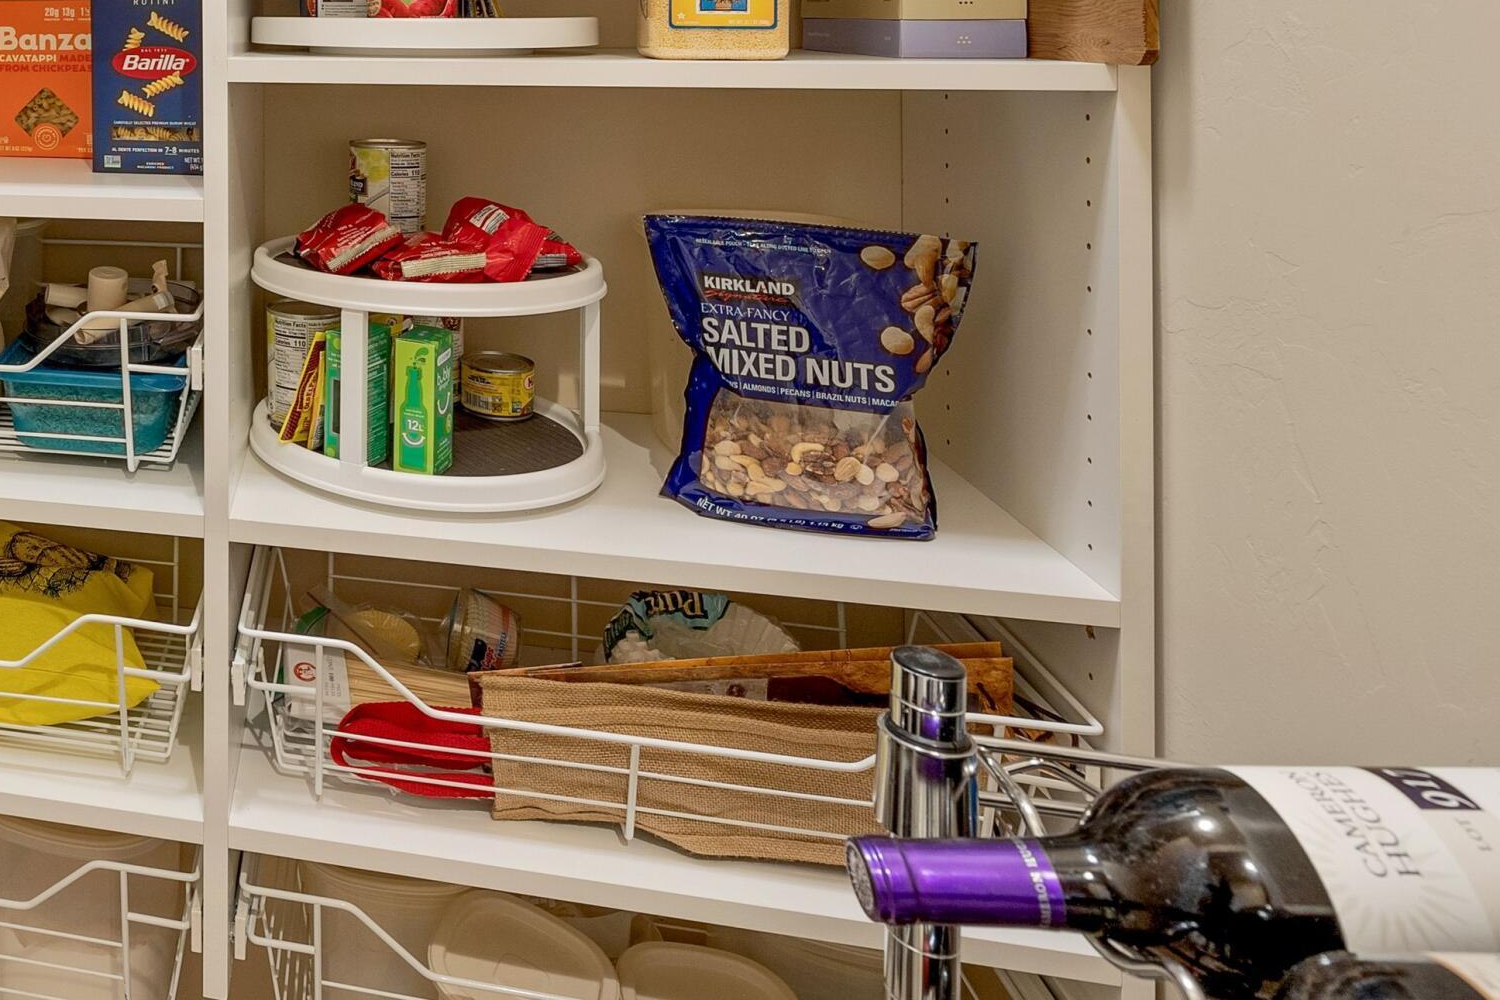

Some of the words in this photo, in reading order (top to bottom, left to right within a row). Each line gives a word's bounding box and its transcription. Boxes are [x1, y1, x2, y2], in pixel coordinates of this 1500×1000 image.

[44, 7, 59, 18] 20g
[62, 7, 75, 18] 13g
[0, 54, 57, 63] CAVATAPPI
[59, 54, 92, 63] MADE
[122, 54, 186, 71] Barilla
[0, 65, 31, 73] FROM
[703, 275, 795, 296] KIRKLAND
[702, 317, 810, 354] SALTED
[706, 345, 796, 383] MIXED
[806, 357, 896, 394] NUTS
[743, 383, 776, 394] ALMONDS
[780, 387, 811, 399] PECANS
[815, 391, 844, 402] BRAZIL
[845, 394, 868, 405] NUTS
[696, 497, 716, 512] NET
[716, 505, 732, 516] WT
